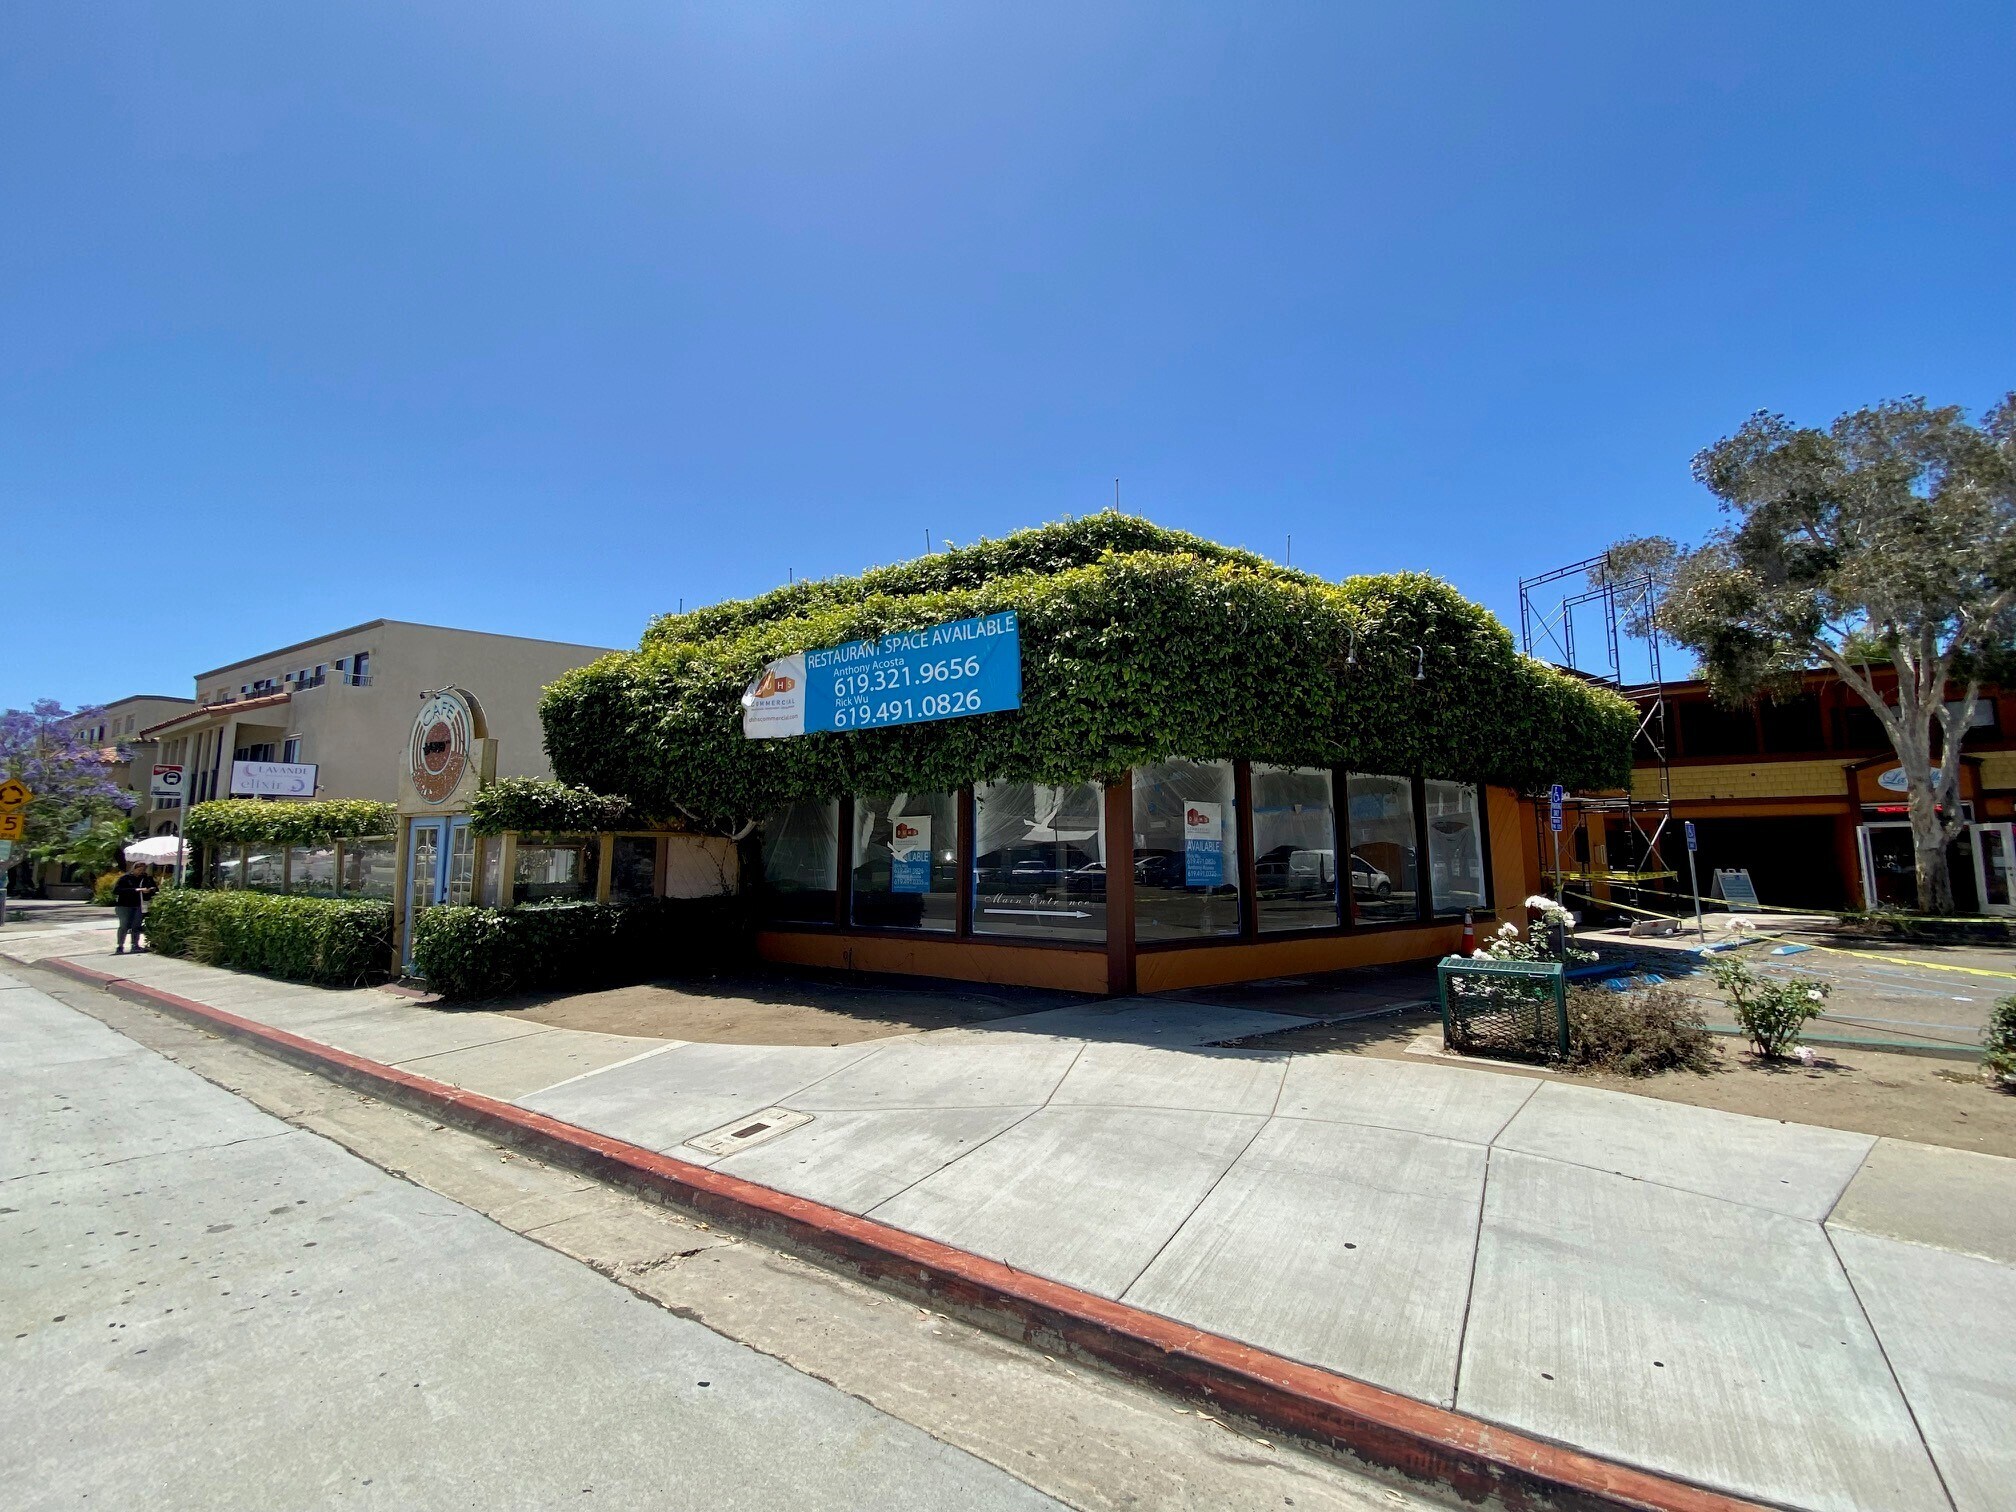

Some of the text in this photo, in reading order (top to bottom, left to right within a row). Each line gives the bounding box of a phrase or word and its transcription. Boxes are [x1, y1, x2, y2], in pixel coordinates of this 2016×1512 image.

[808, 615, 1014, 669] RESTAURANT SPACE AVAILABLE
[833, 657, 905, 678] Anthony Acosta
[834, 655, 980, 697] 619.321.9656
[834, 688, 982, 727] 619.491.0826
[835, 695, 869, 707] Rick Wu
[423, 701, 456, 726] CAFE
[3, 816, 17, 831] 5
[1187, 842, 1220, 852] AVAILABLE
[984, 892, 1090, 906] Main Entrnce
